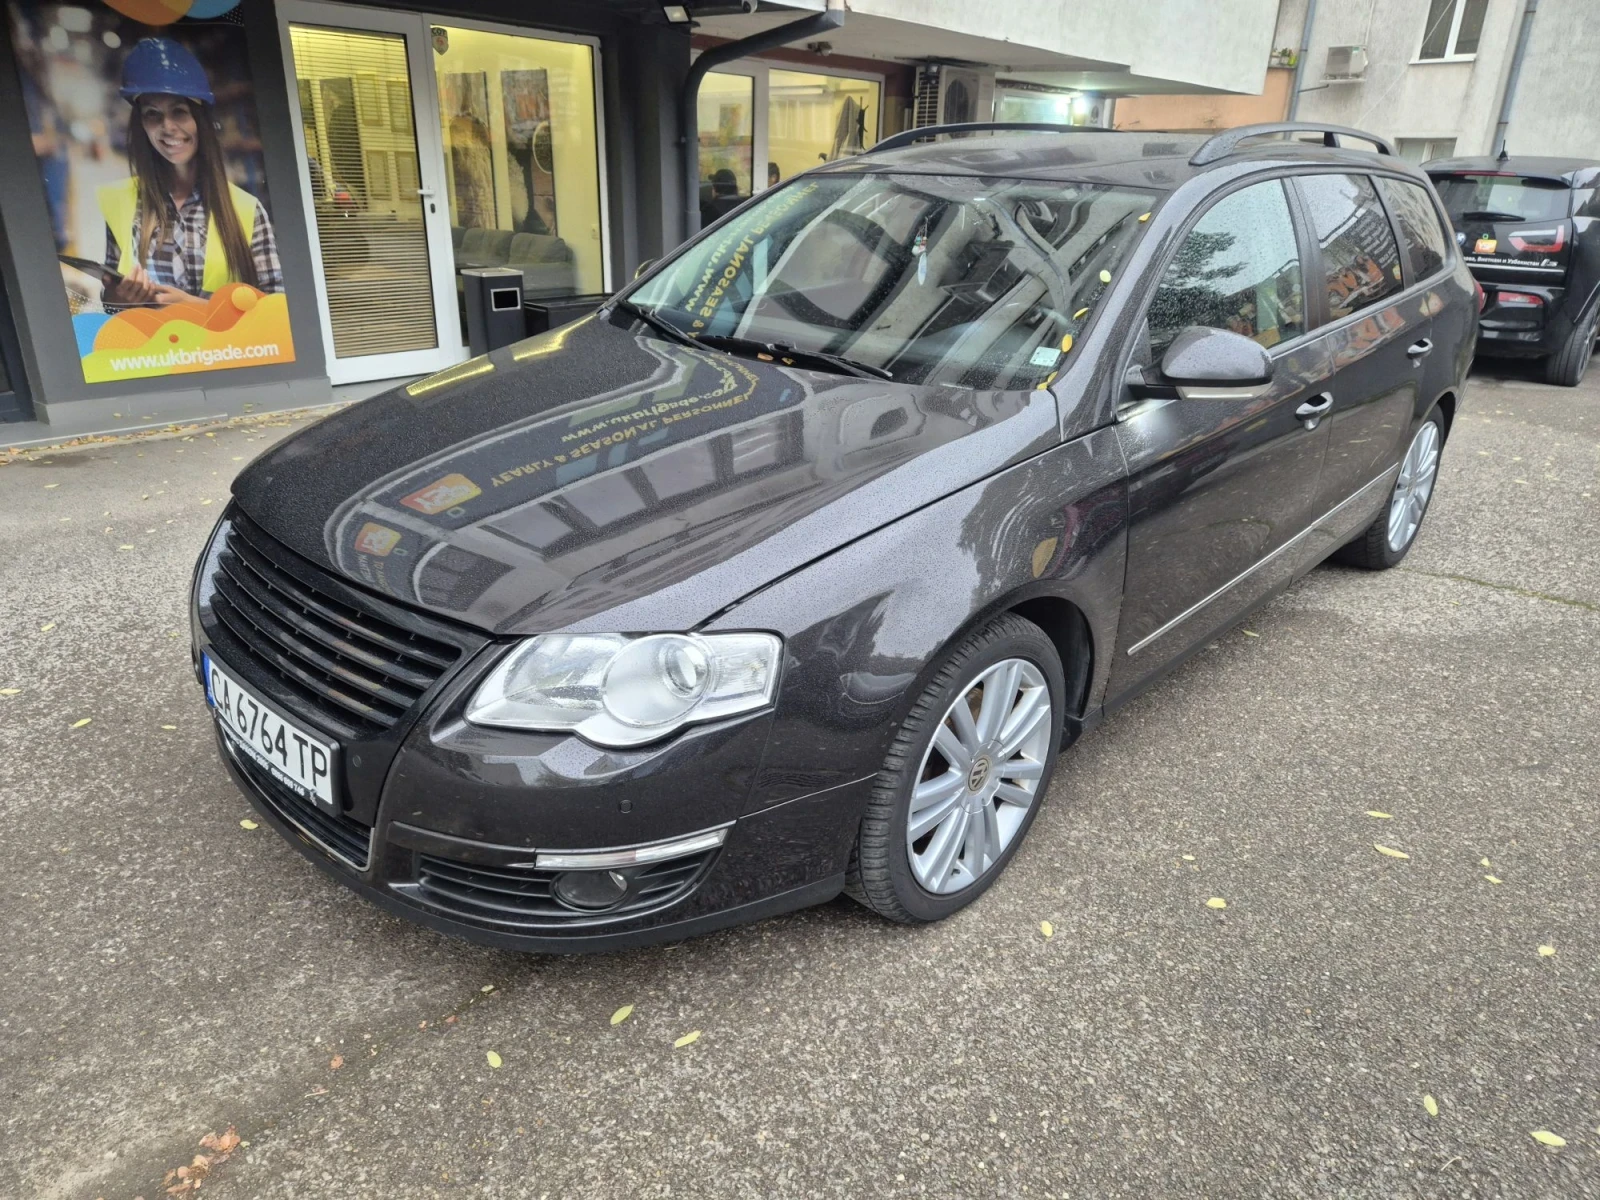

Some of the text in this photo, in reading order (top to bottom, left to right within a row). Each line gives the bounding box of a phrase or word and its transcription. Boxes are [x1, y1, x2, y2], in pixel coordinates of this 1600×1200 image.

[110, 343, 280, 372] www.ukbrigade.com
[236, 692, 288, 767] 6764
[292, 732, 328, 788] TP
